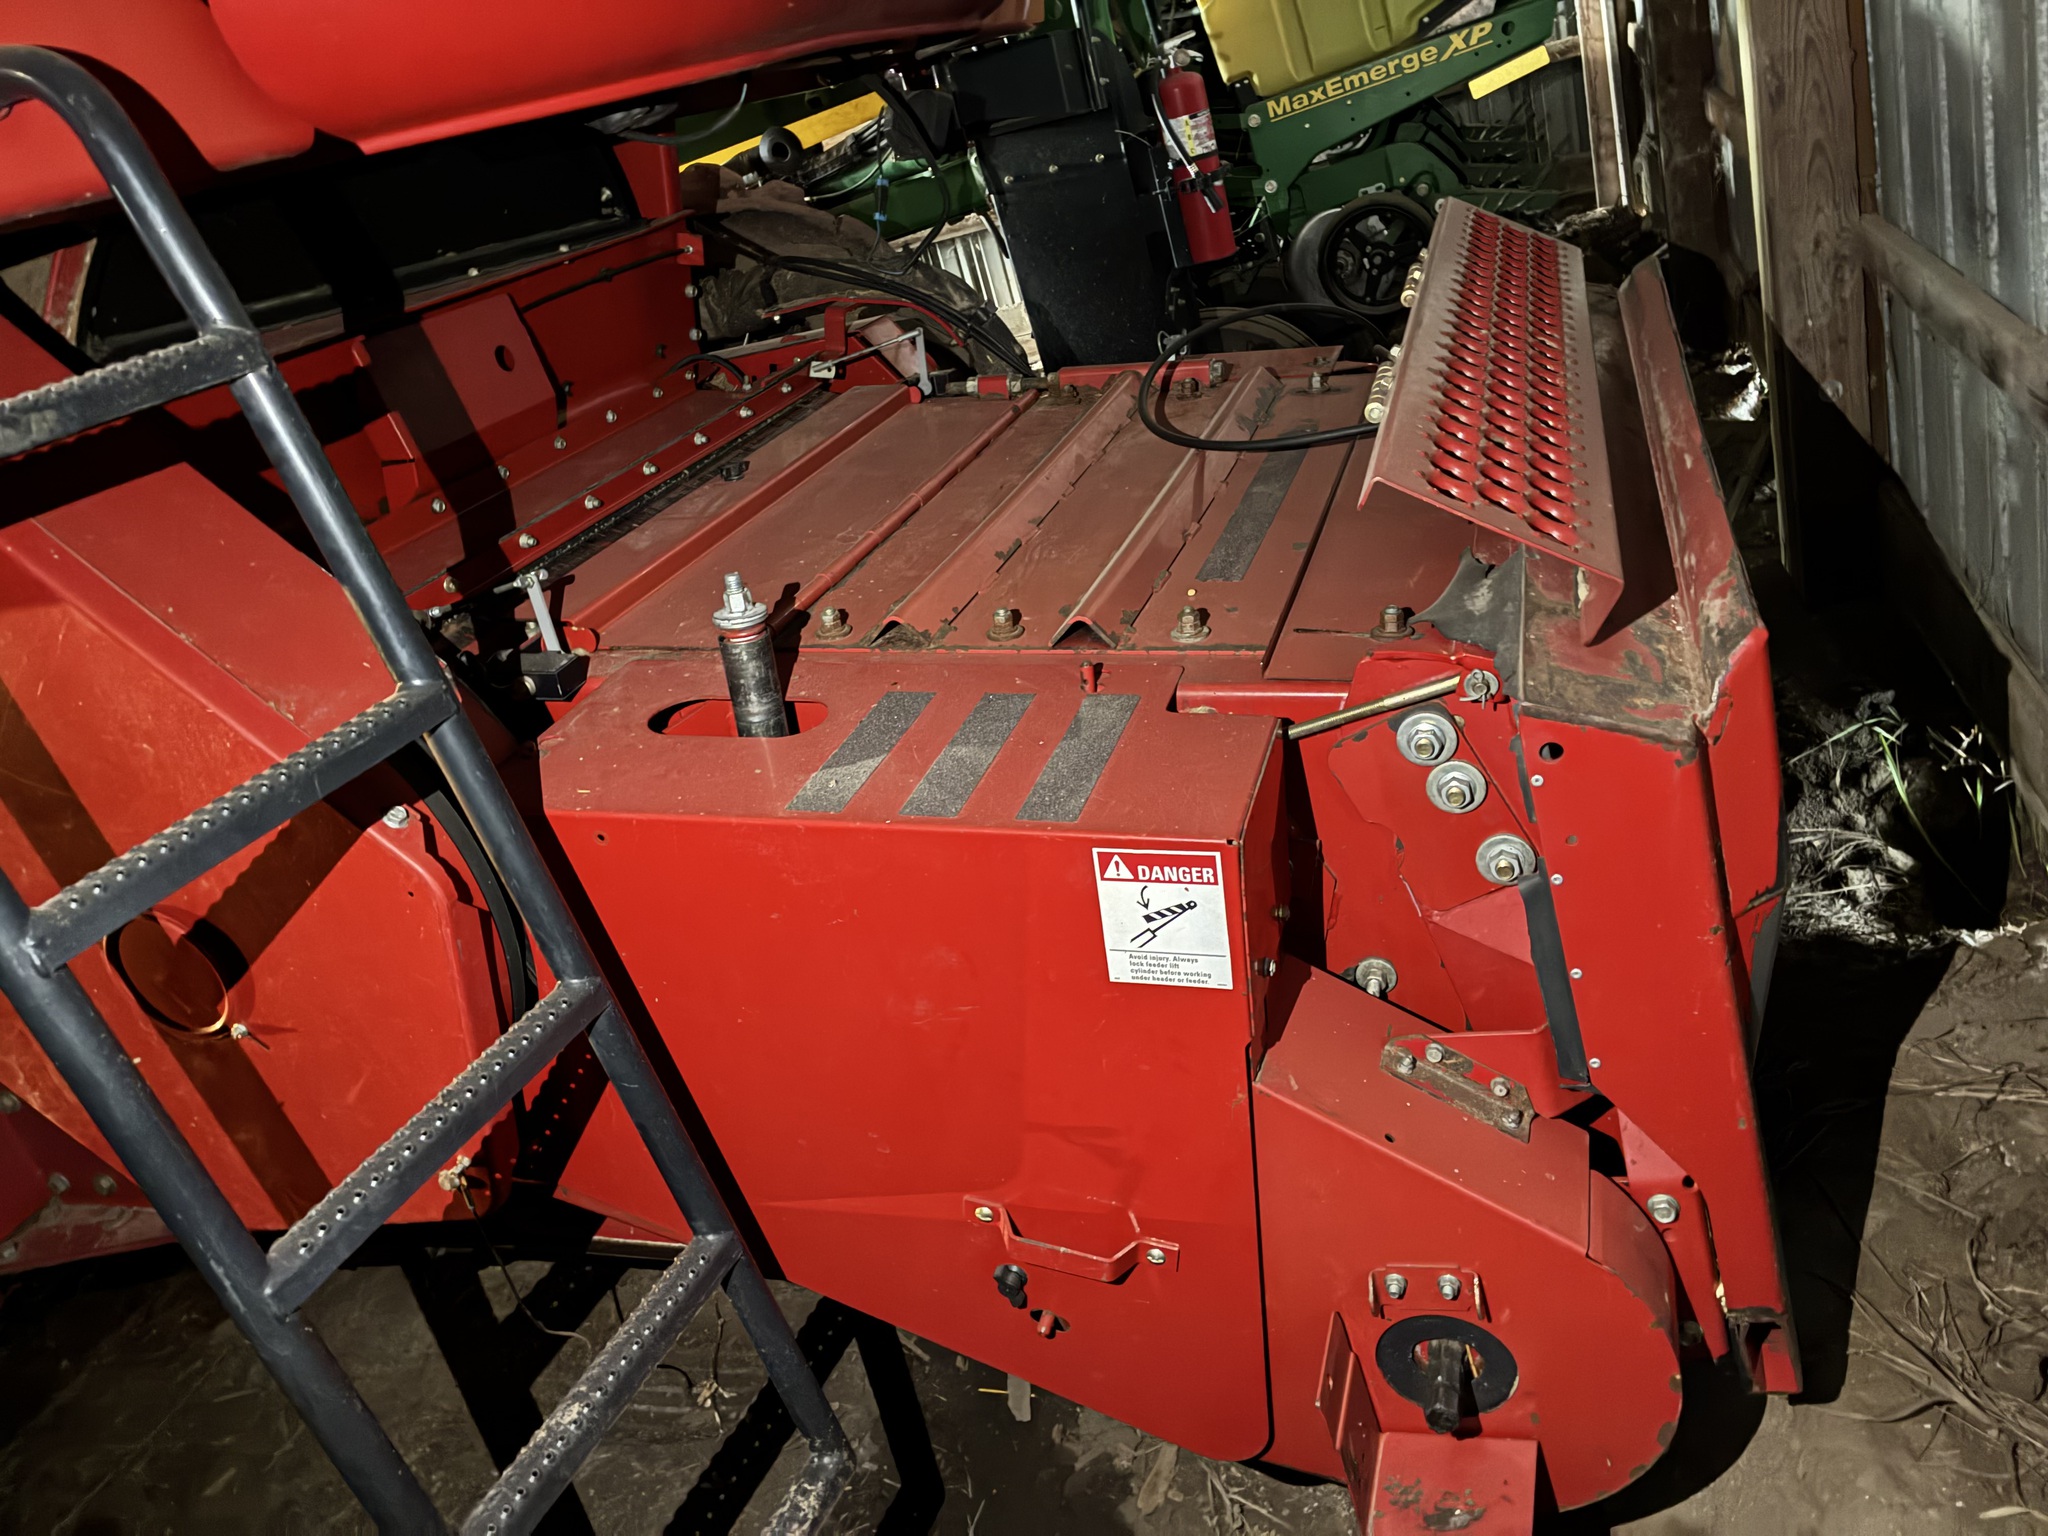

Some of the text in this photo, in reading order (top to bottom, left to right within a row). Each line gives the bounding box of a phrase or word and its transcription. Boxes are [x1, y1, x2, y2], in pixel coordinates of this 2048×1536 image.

[1266, 21, 1493, 118] MaxEmerge XP
[1137, 865, 1215, 883] DANGER
[1149, 954, 1171, 962] injury.
[1173, 956, 1199, 964] Always
[1183, 971, 1212, 979] working
